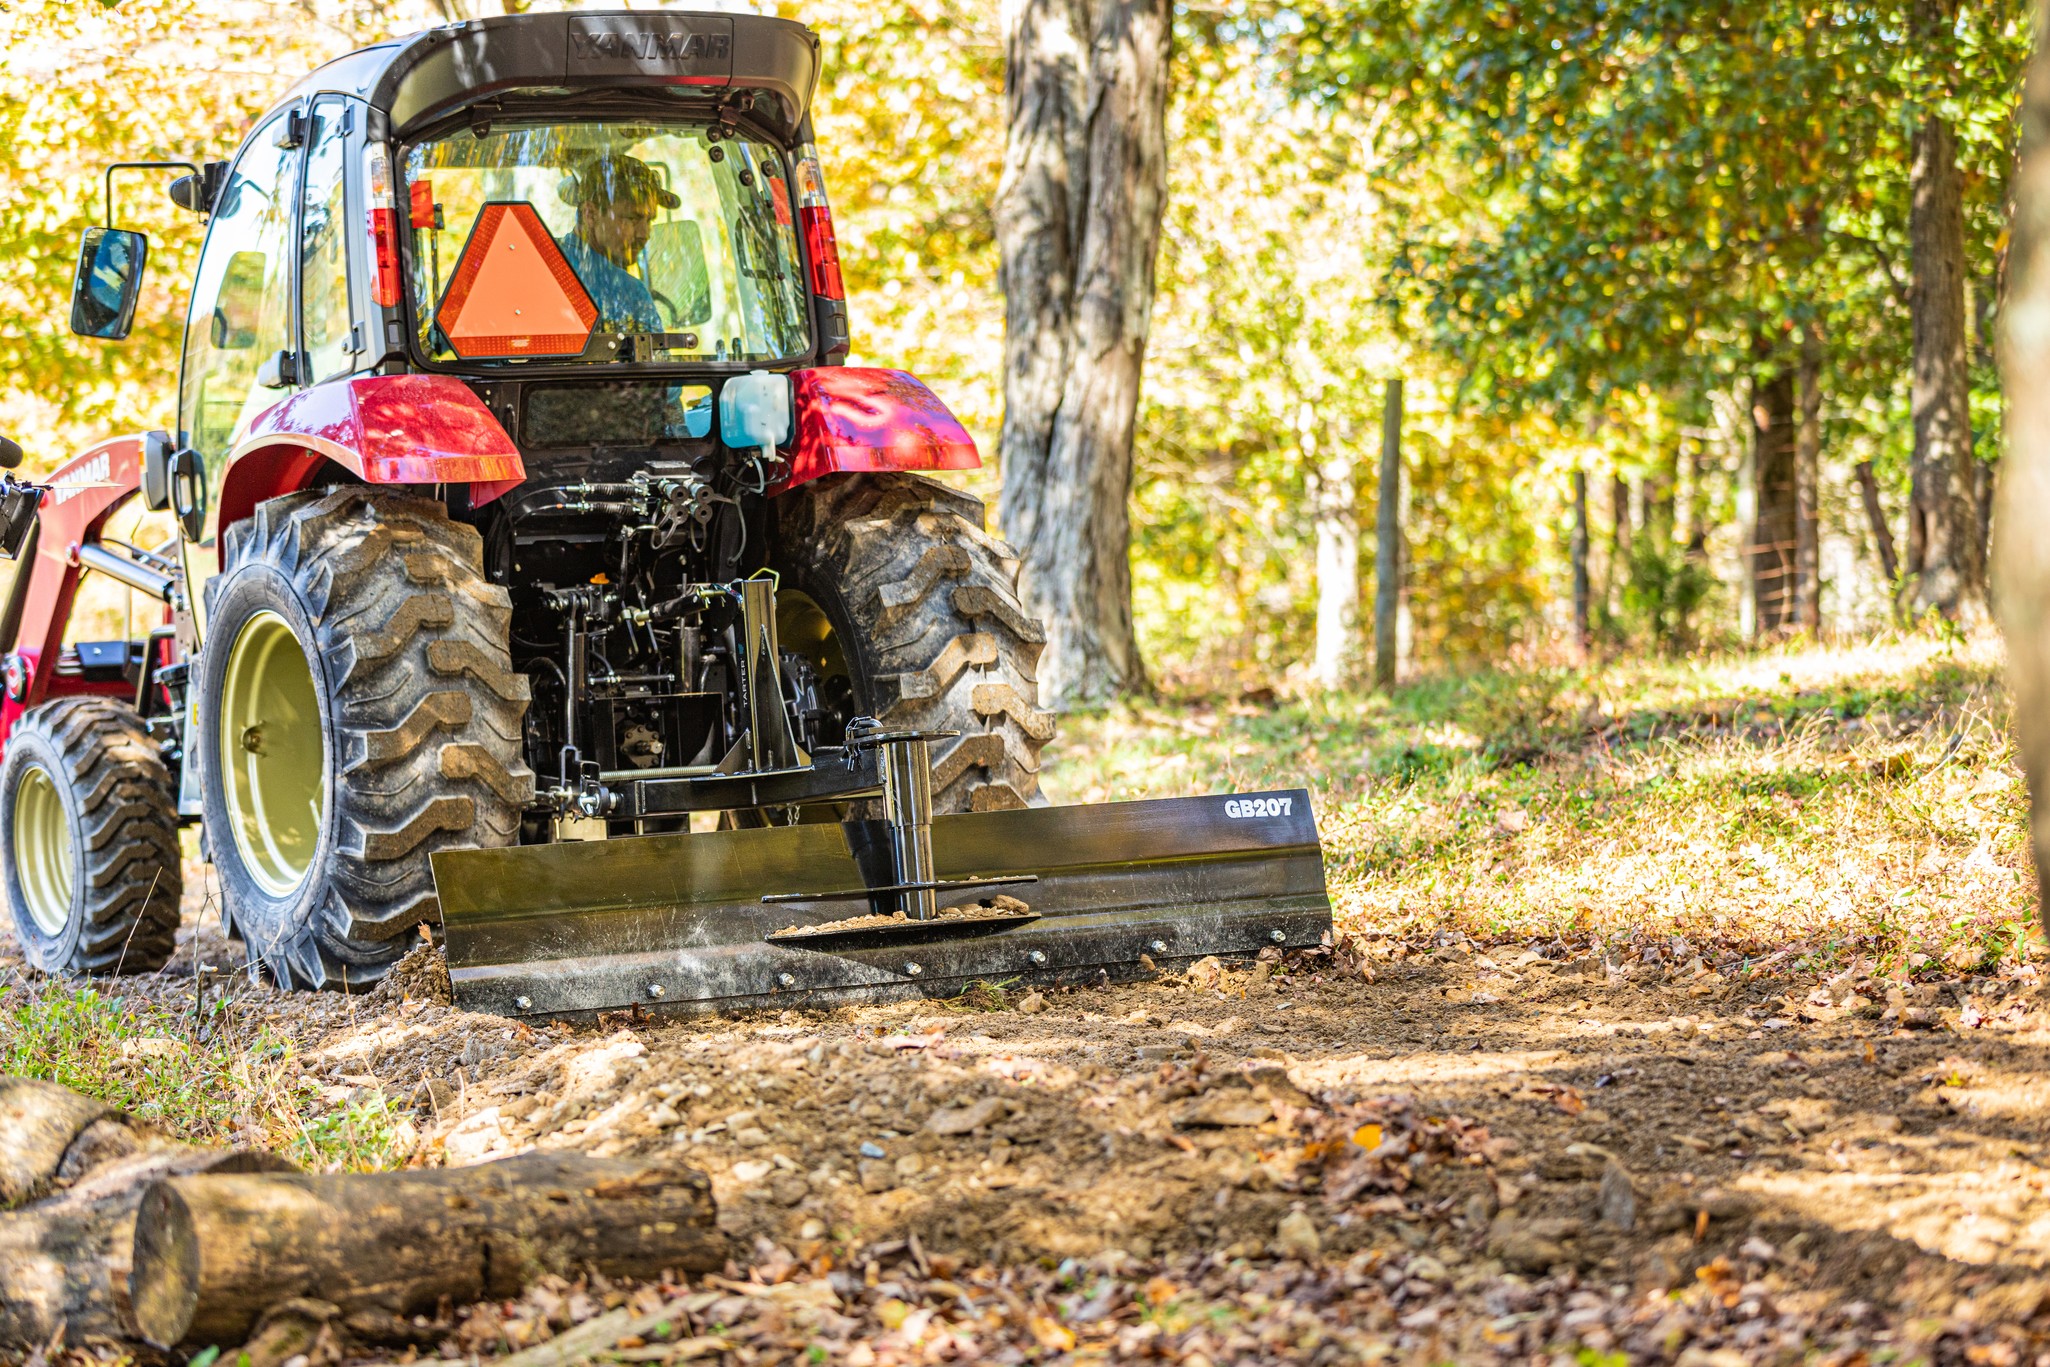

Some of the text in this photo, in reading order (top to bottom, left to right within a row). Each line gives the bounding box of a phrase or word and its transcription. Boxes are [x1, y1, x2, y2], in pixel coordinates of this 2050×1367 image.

[571, 32, 731, 60] YANMAR
[740, 660, 748, 708] TARTER
[1224, 797, 1292, 819] GB207
